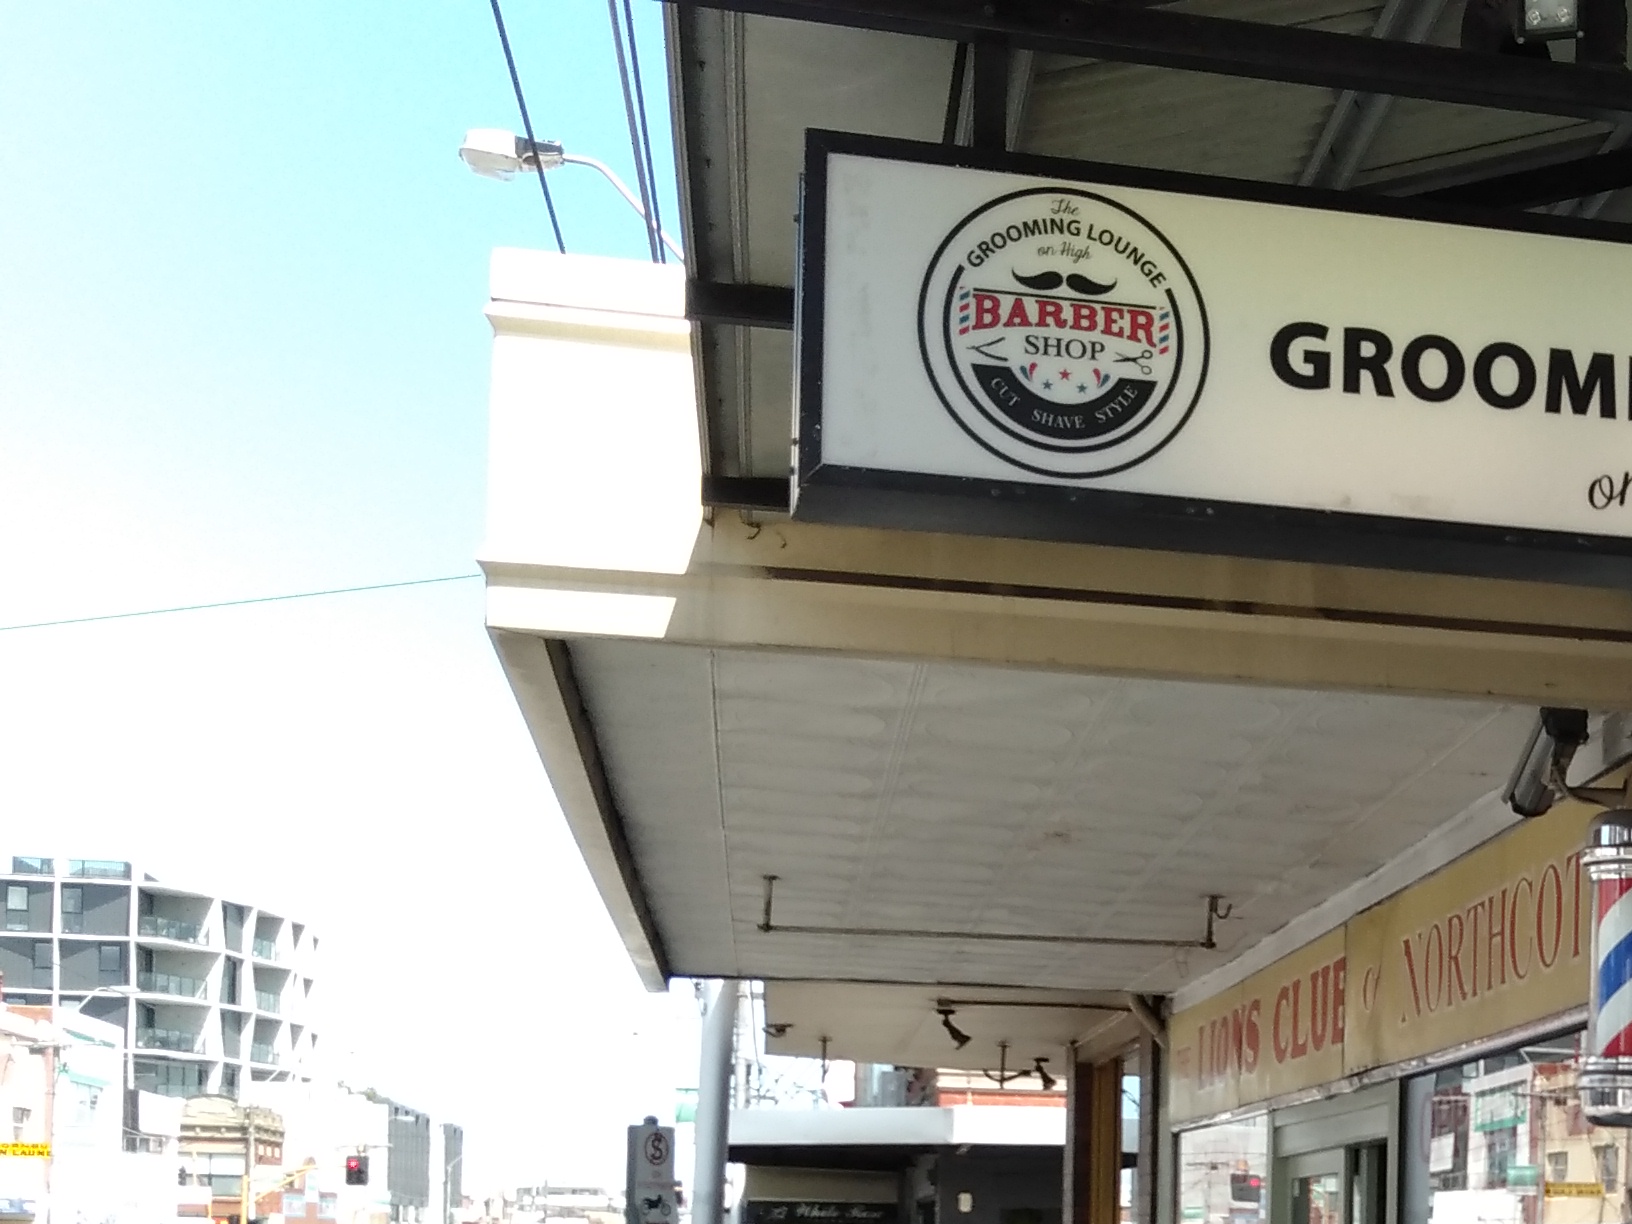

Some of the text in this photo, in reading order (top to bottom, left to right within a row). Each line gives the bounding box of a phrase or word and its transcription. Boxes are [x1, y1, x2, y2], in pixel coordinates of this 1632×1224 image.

[1051, 199, 1080, 216] The
[967, 218, 1167, 289] GROOMING LOUNGE
[1038, 241, 1092, 264] on High
[972, 293, 1157, 348] BARBER
[1024, 334, 1106, 361] SHOP
[991, 377, 1138, 429] CUT SHAVE STYLE
[1198, 998, 1261, 1091] LIONS
